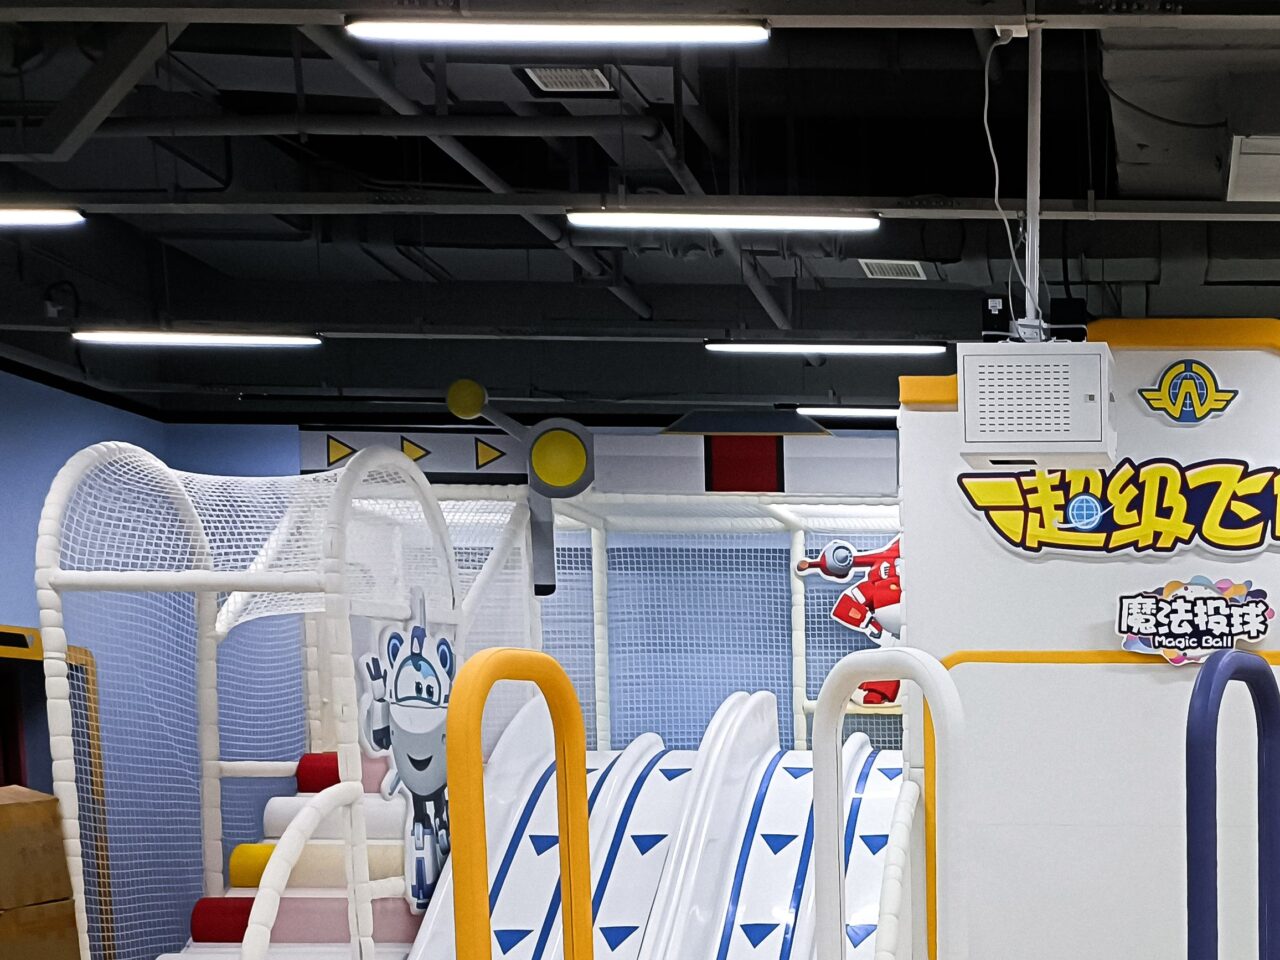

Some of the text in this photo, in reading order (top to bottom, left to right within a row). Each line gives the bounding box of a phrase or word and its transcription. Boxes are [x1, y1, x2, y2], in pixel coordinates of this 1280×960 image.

[1120, 597, 1268, 637] 魔法投球
[1154, 635, 1232, 649] Magic Ball
